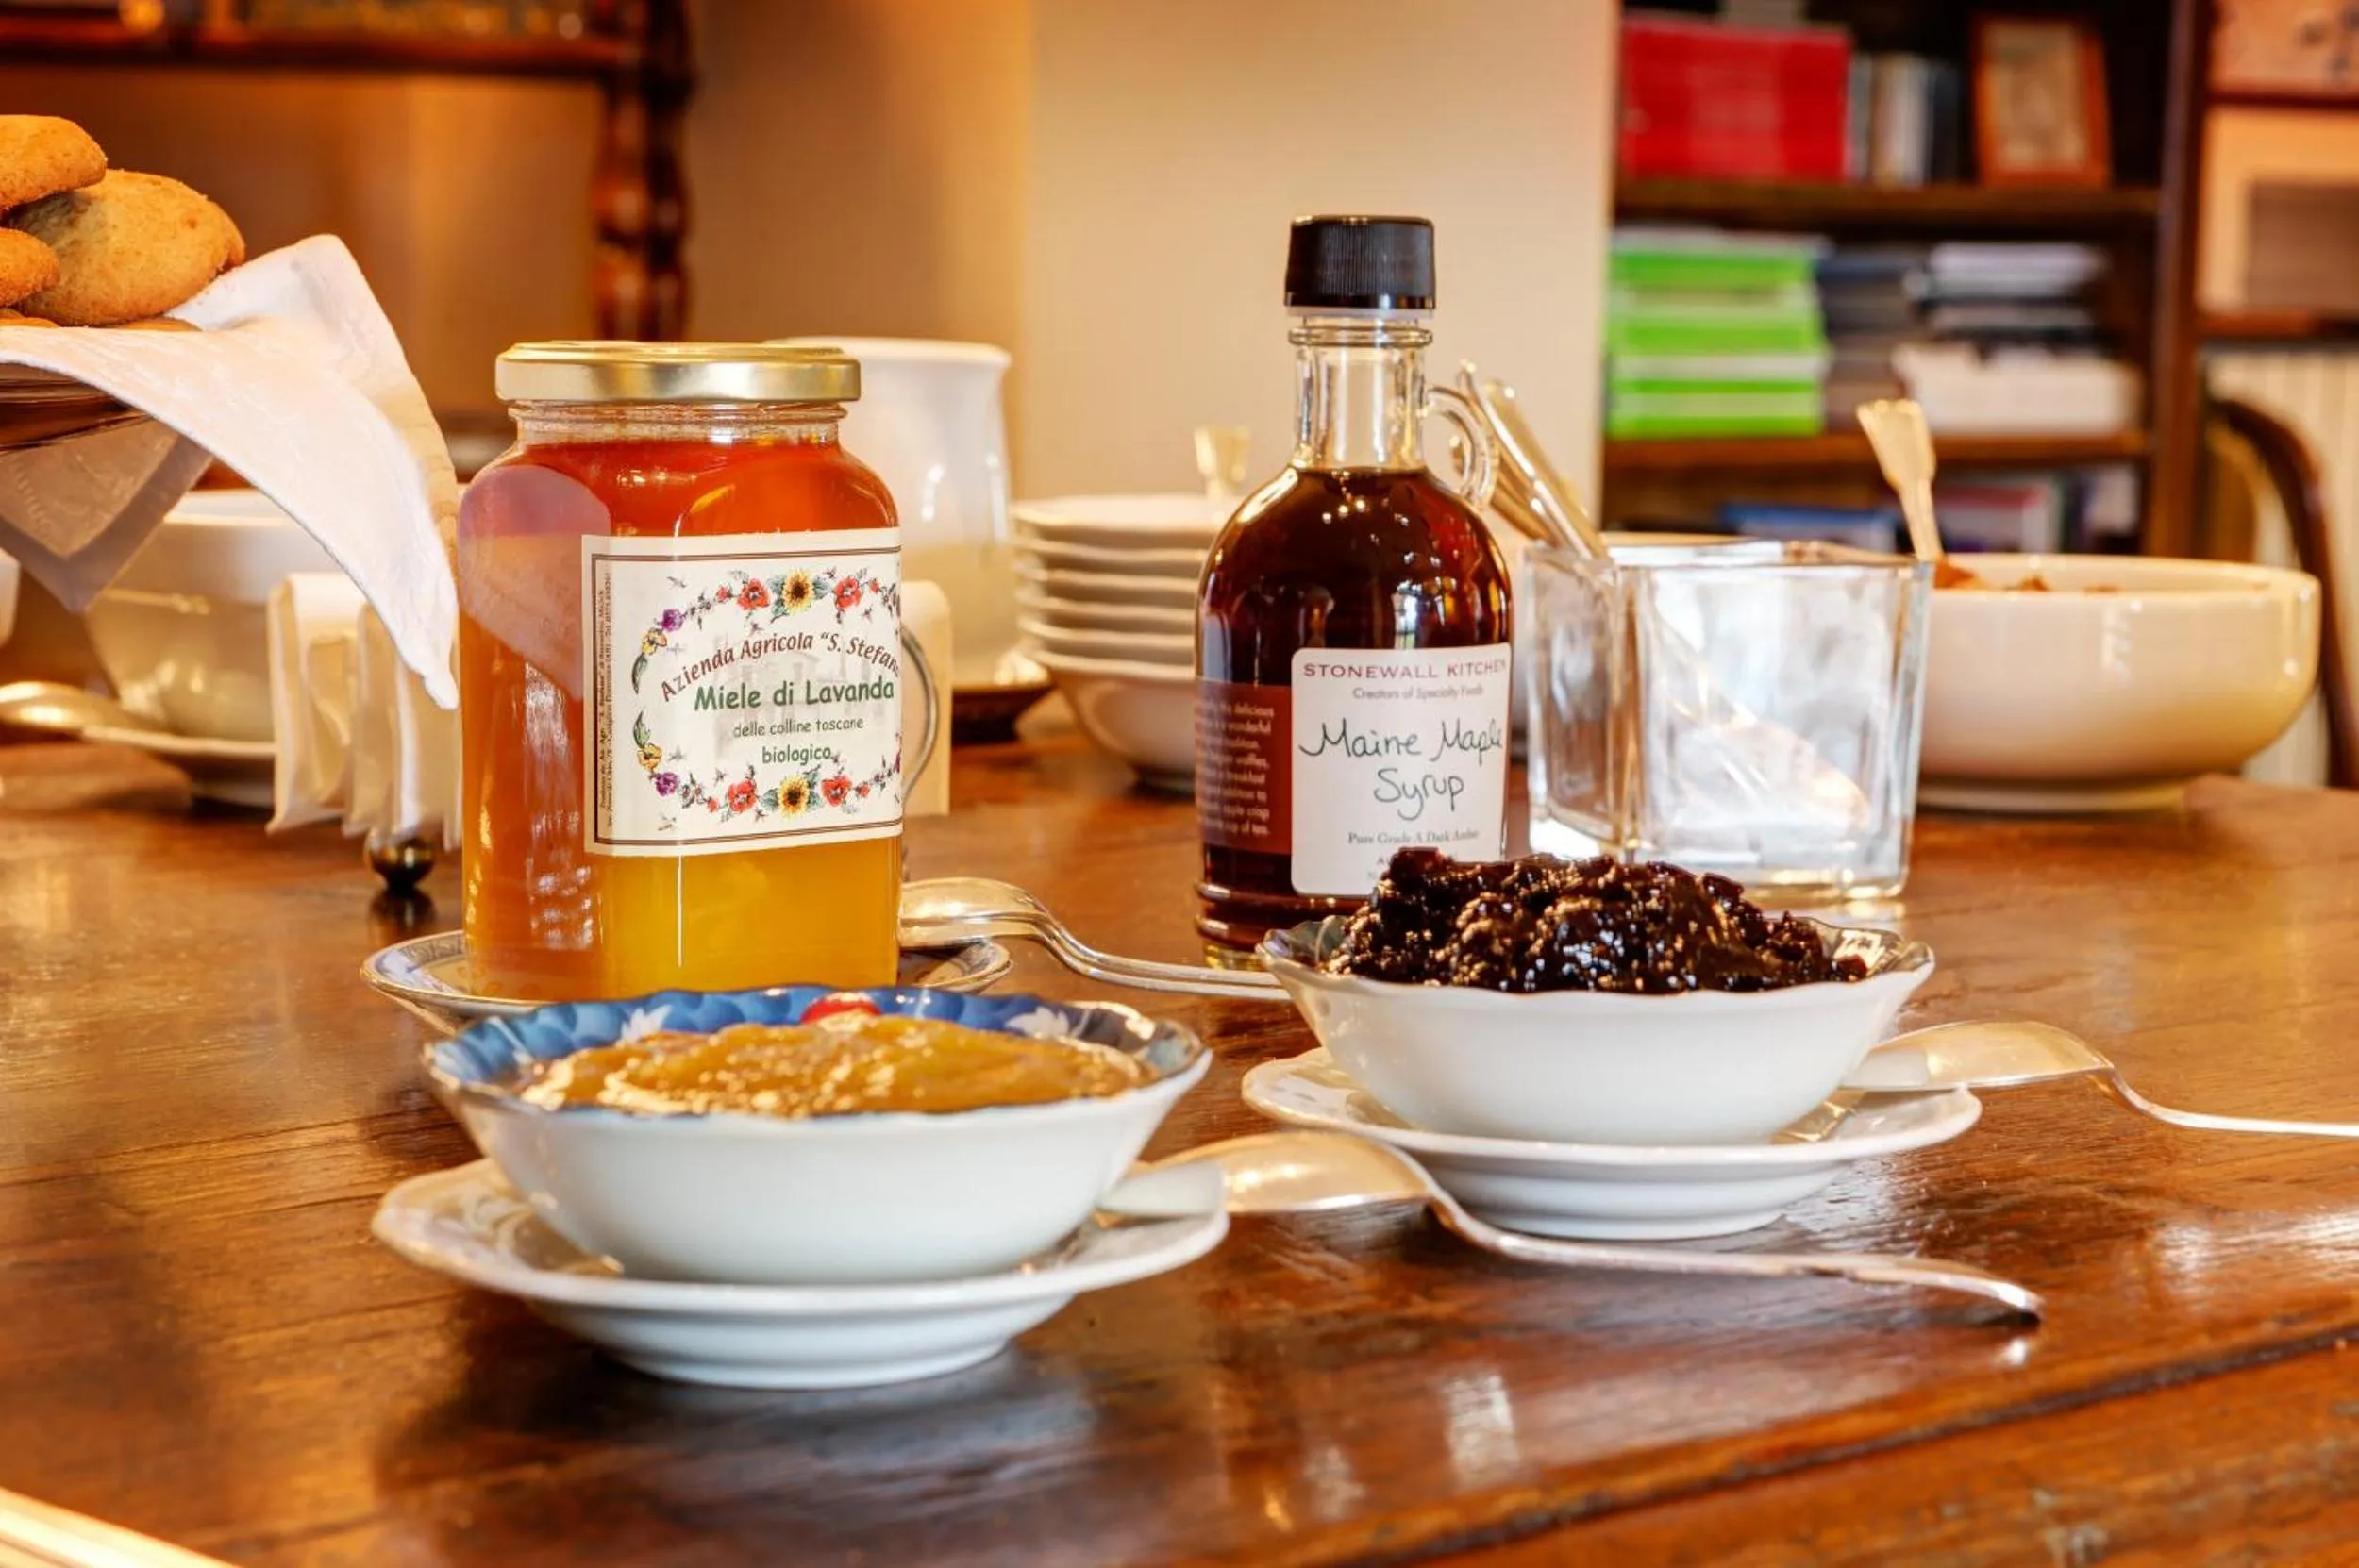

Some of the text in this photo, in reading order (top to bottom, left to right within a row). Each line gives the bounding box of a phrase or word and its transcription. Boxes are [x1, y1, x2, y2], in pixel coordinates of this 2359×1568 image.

[661, 647, 735, 702] Azienda
[740, 632, 813, 659] Agricola
[1303, 662, 1439, 679] STONEWALL
[694, 675, 895, 711] Miele di Lavanda
[1351, 686, 1399, 700] Creators
[1401, 686, 1414, 700] of
[732, 717, 864, 738] delle colline toscane
[1298, 717, 1503, 767] Maine Maple
[762, 744, 831, 766] biologico
[1373, 767, 1464, 821] Syrup
[1347, 831, 1374, 844] Pure
[1377, 831, 1411, 844] Grade
[1414, 832, 1424, 843] A
[1426, 830, 1450, 843] Dark
